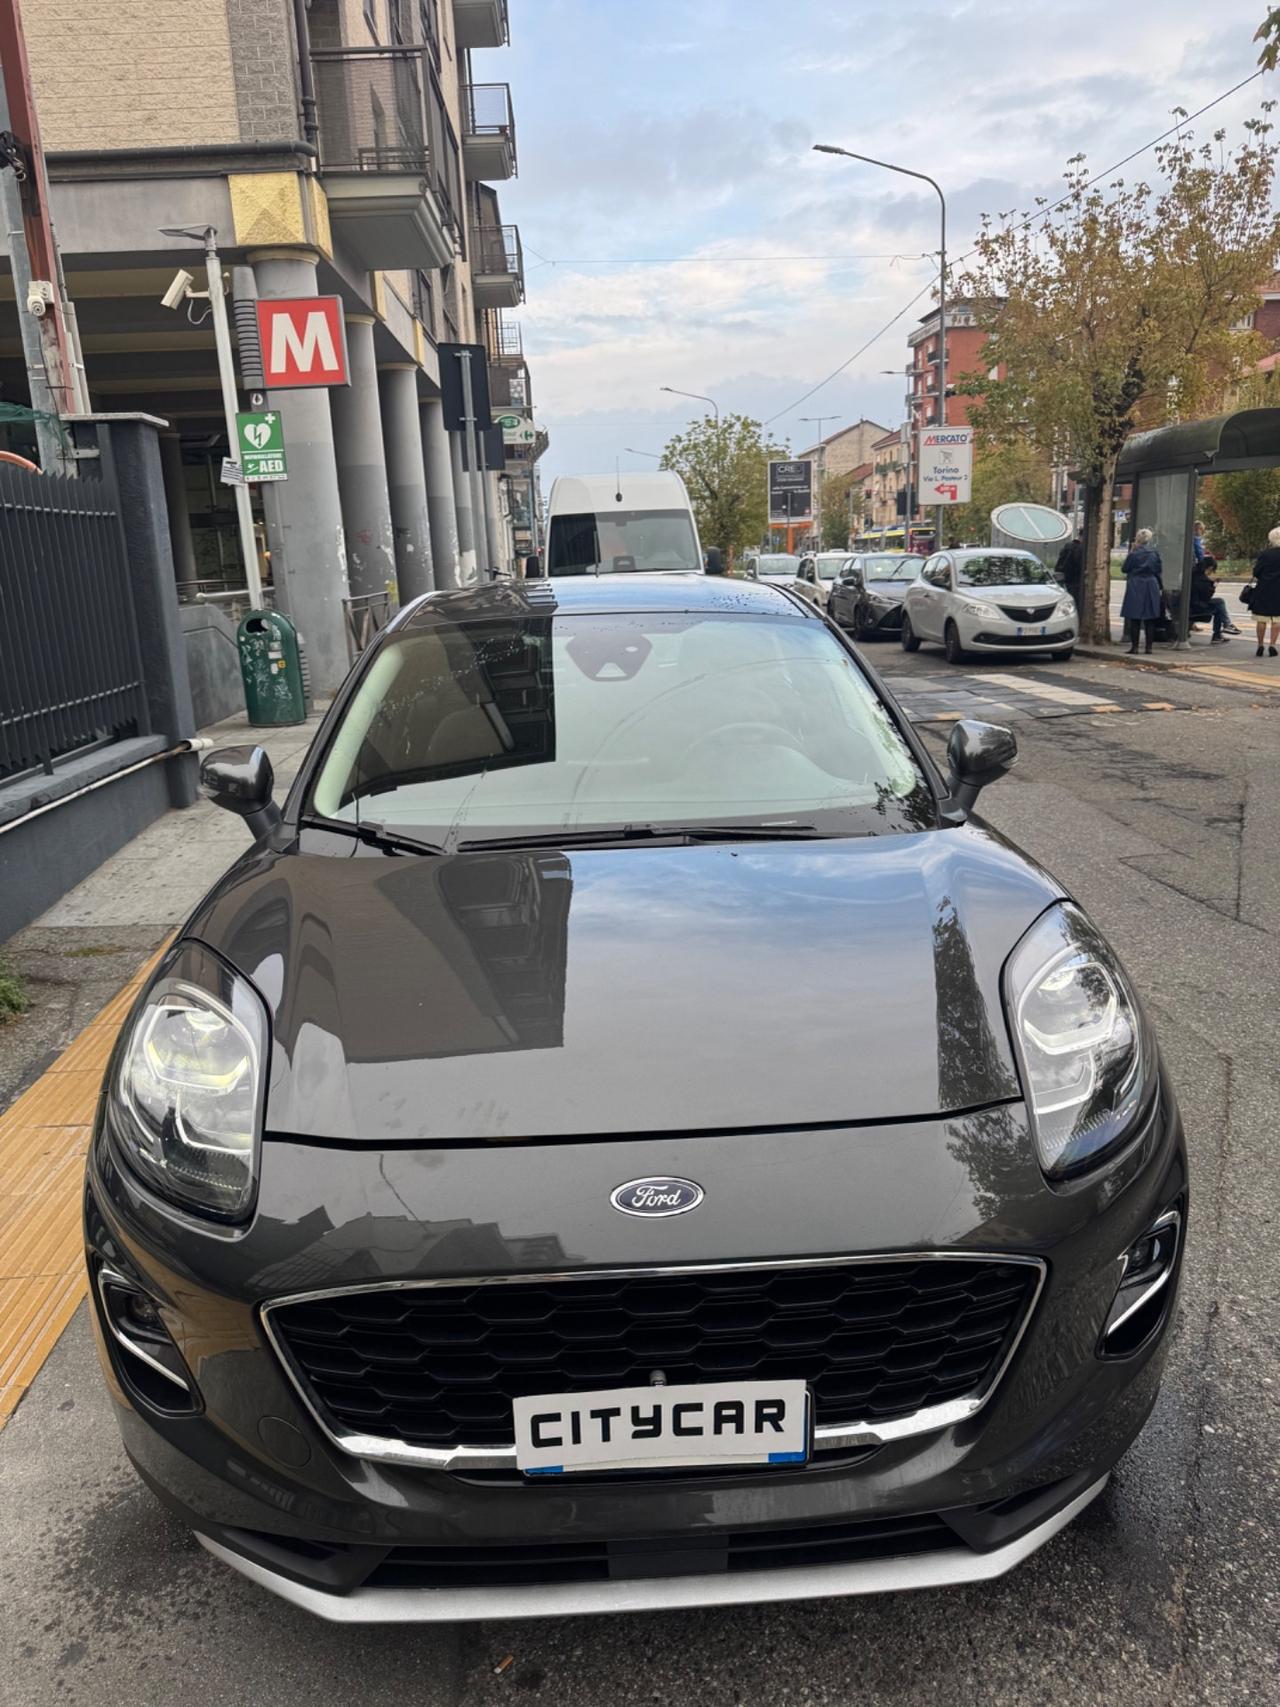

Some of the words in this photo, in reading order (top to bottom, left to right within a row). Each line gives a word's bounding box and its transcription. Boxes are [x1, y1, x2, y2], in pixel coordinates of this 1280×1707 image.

[271, 311, 340, 373] M
[259, 460, 284, 473] AED
[933, 466, 959, 474] Torino
[631, 1185, 681, 1207] Ford
[530, 1399, 786, 1449] CITYCAR
